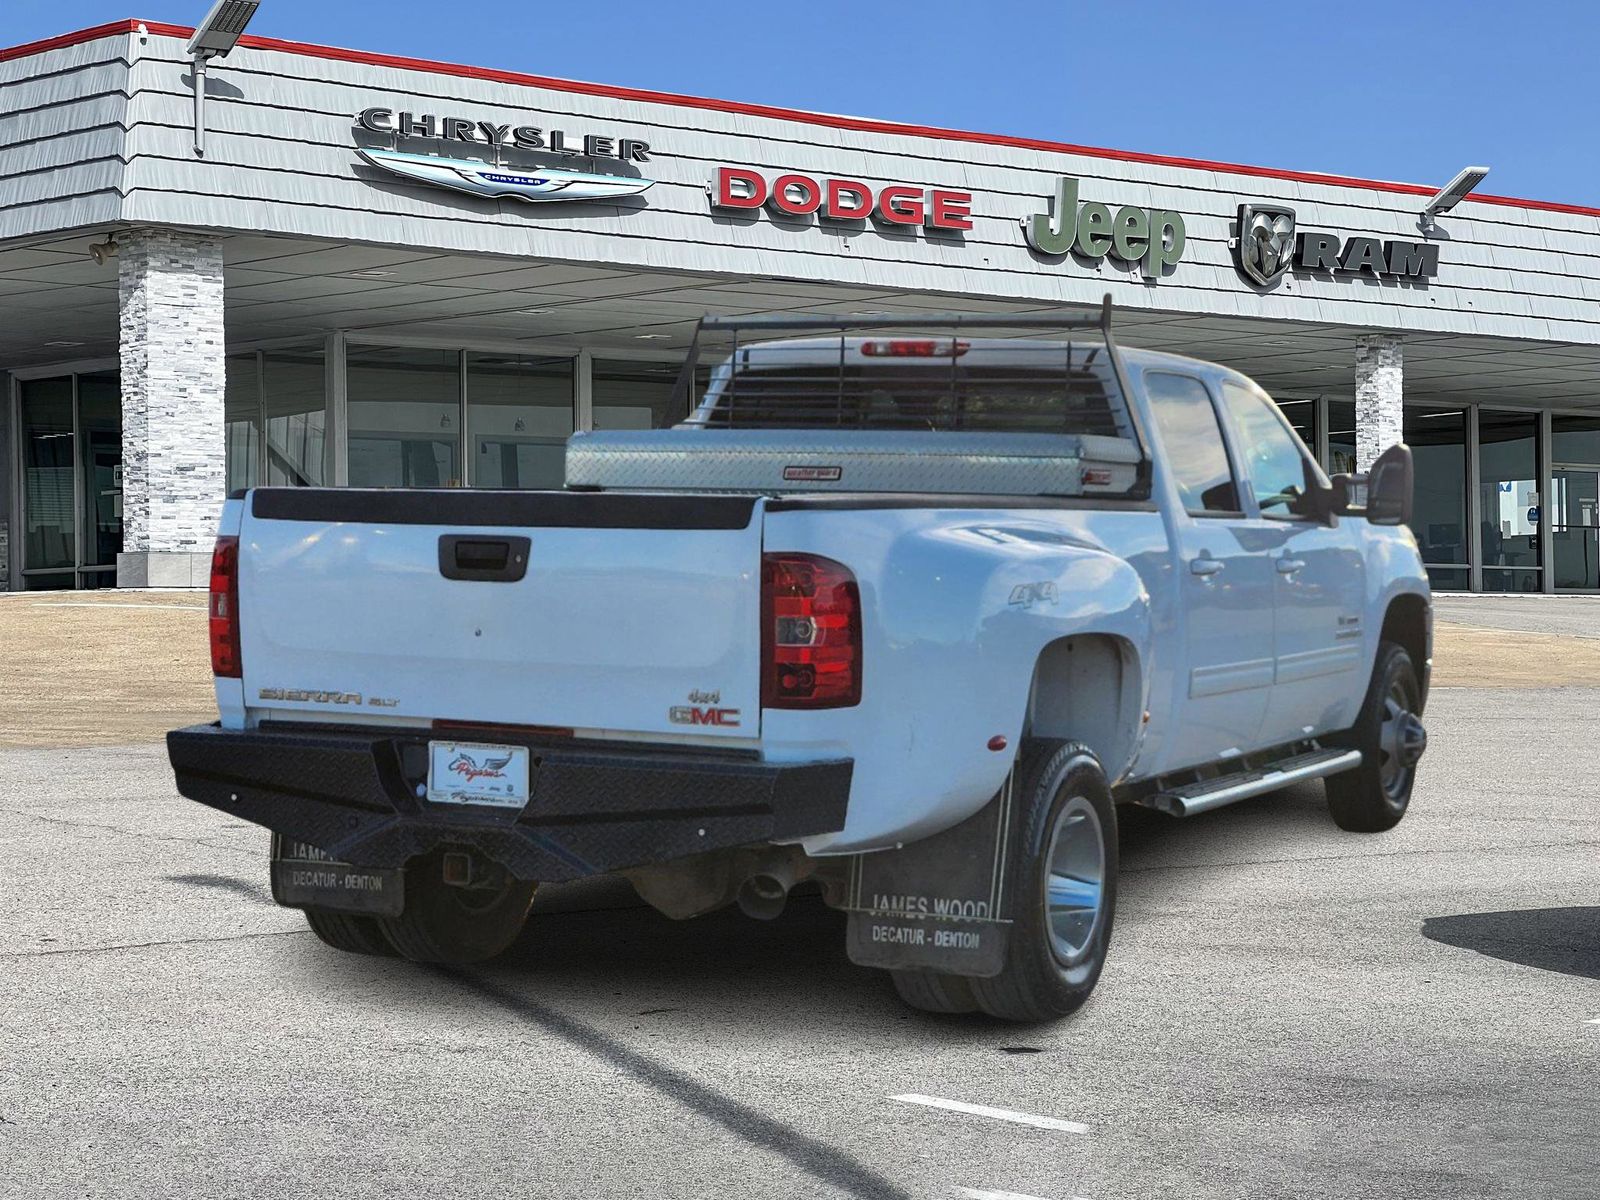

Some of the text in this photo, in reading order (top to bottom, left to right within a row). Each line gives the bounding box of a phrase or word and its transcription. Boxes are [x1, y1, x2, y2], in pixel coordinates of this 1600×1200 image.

[354, 107, 651, 163] CHRYSLER
[484, 174, 541, 185] CHRYSLER
[712, 167, 973, 231] DODGE
[1026, 177, 1187, 279] Jeep
[1297, 232, 1440, 278] RAM
[259, 688, 362, 705] SIERRA
[669, 705, 741, 727] GMC
[293, 871, 337, 887] DECATUR
[345, 874, 383, 891] DENTON
[870, 894, 989, 923] JAMES WOOD
[872, 925, 924, 945] DECATUR
[934, 930, 980, 949] DENTON
